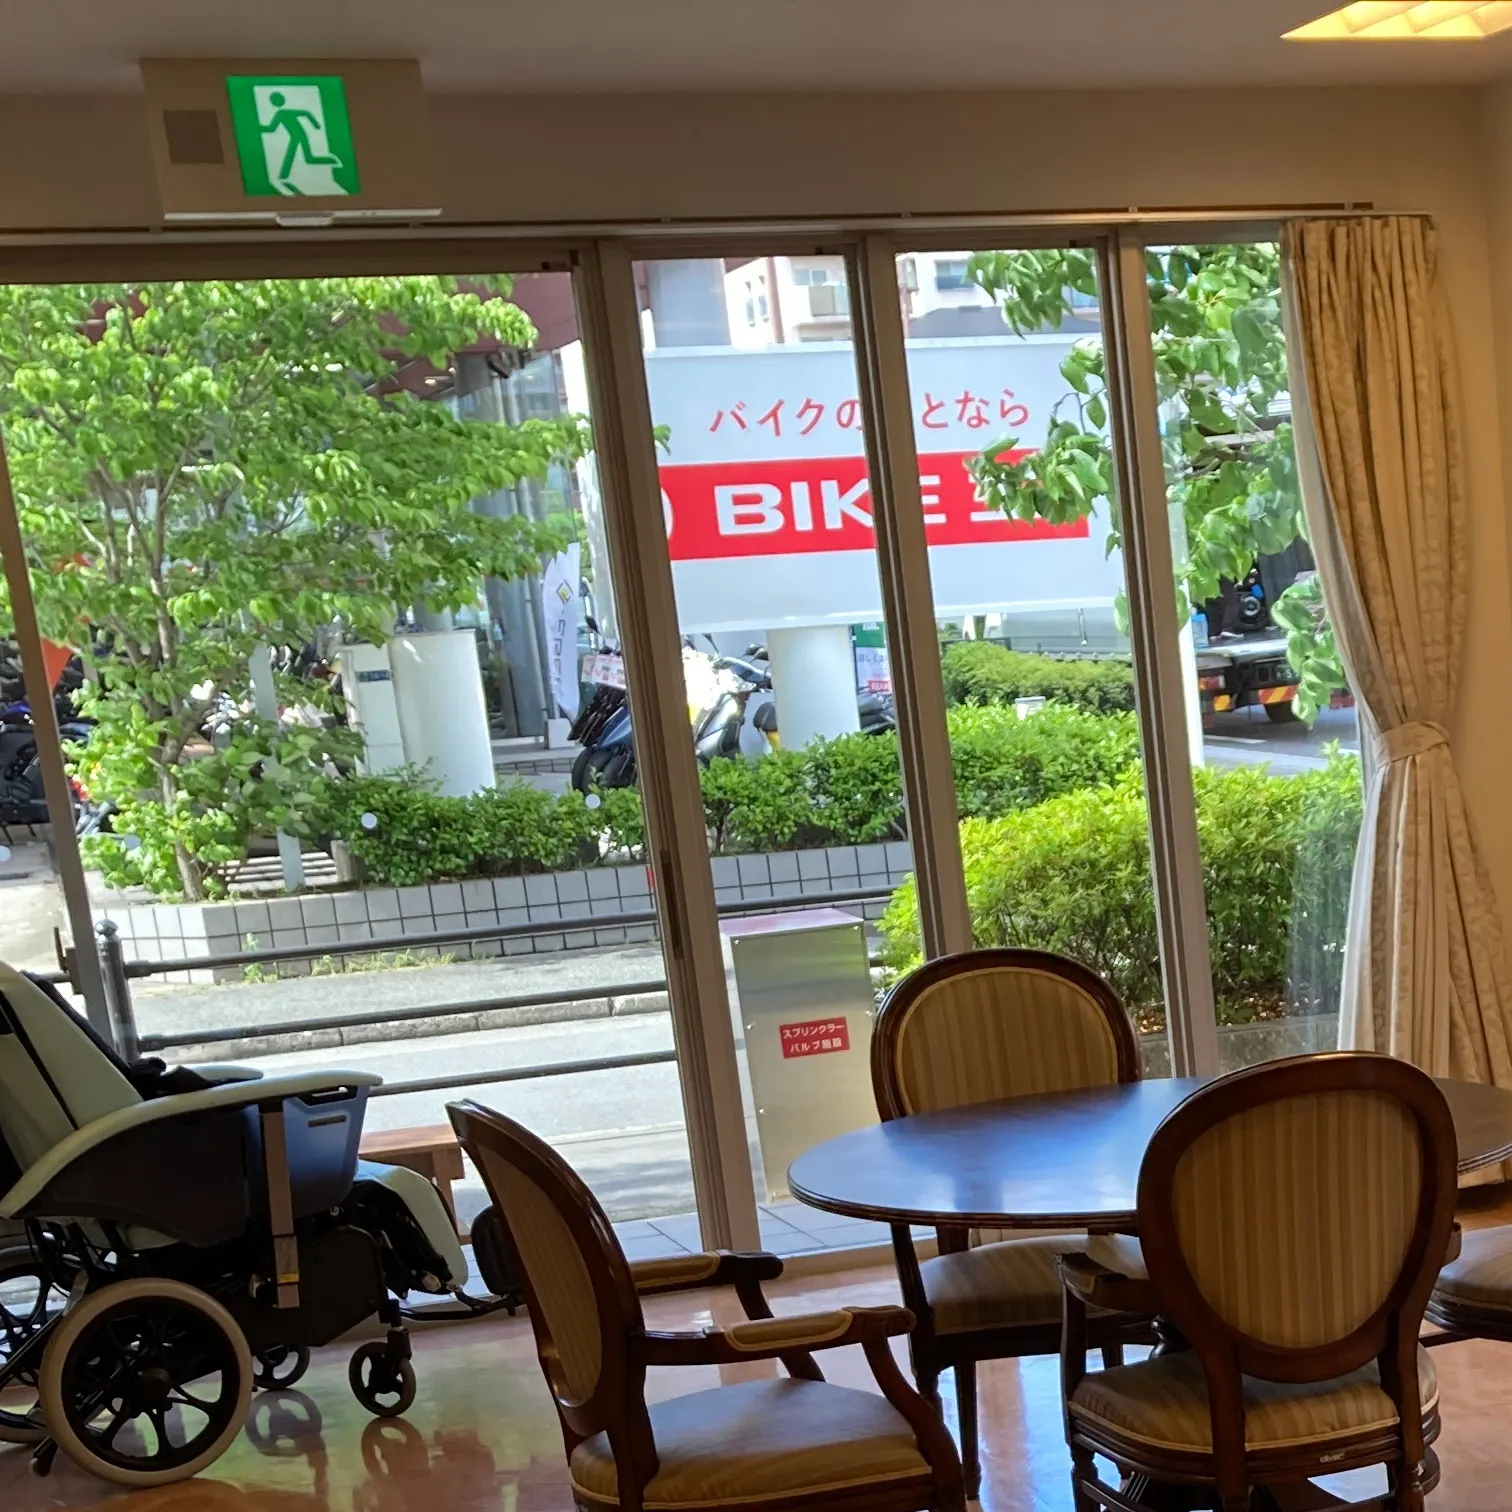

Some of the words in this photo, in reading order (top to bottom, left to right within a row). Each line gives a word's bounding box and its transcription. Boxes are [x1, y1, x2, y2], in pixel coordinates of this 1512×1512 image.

[709, 388, 1030, 437] バイクのとなら
[782, 1023, 845, 1039] スプリンクラー
